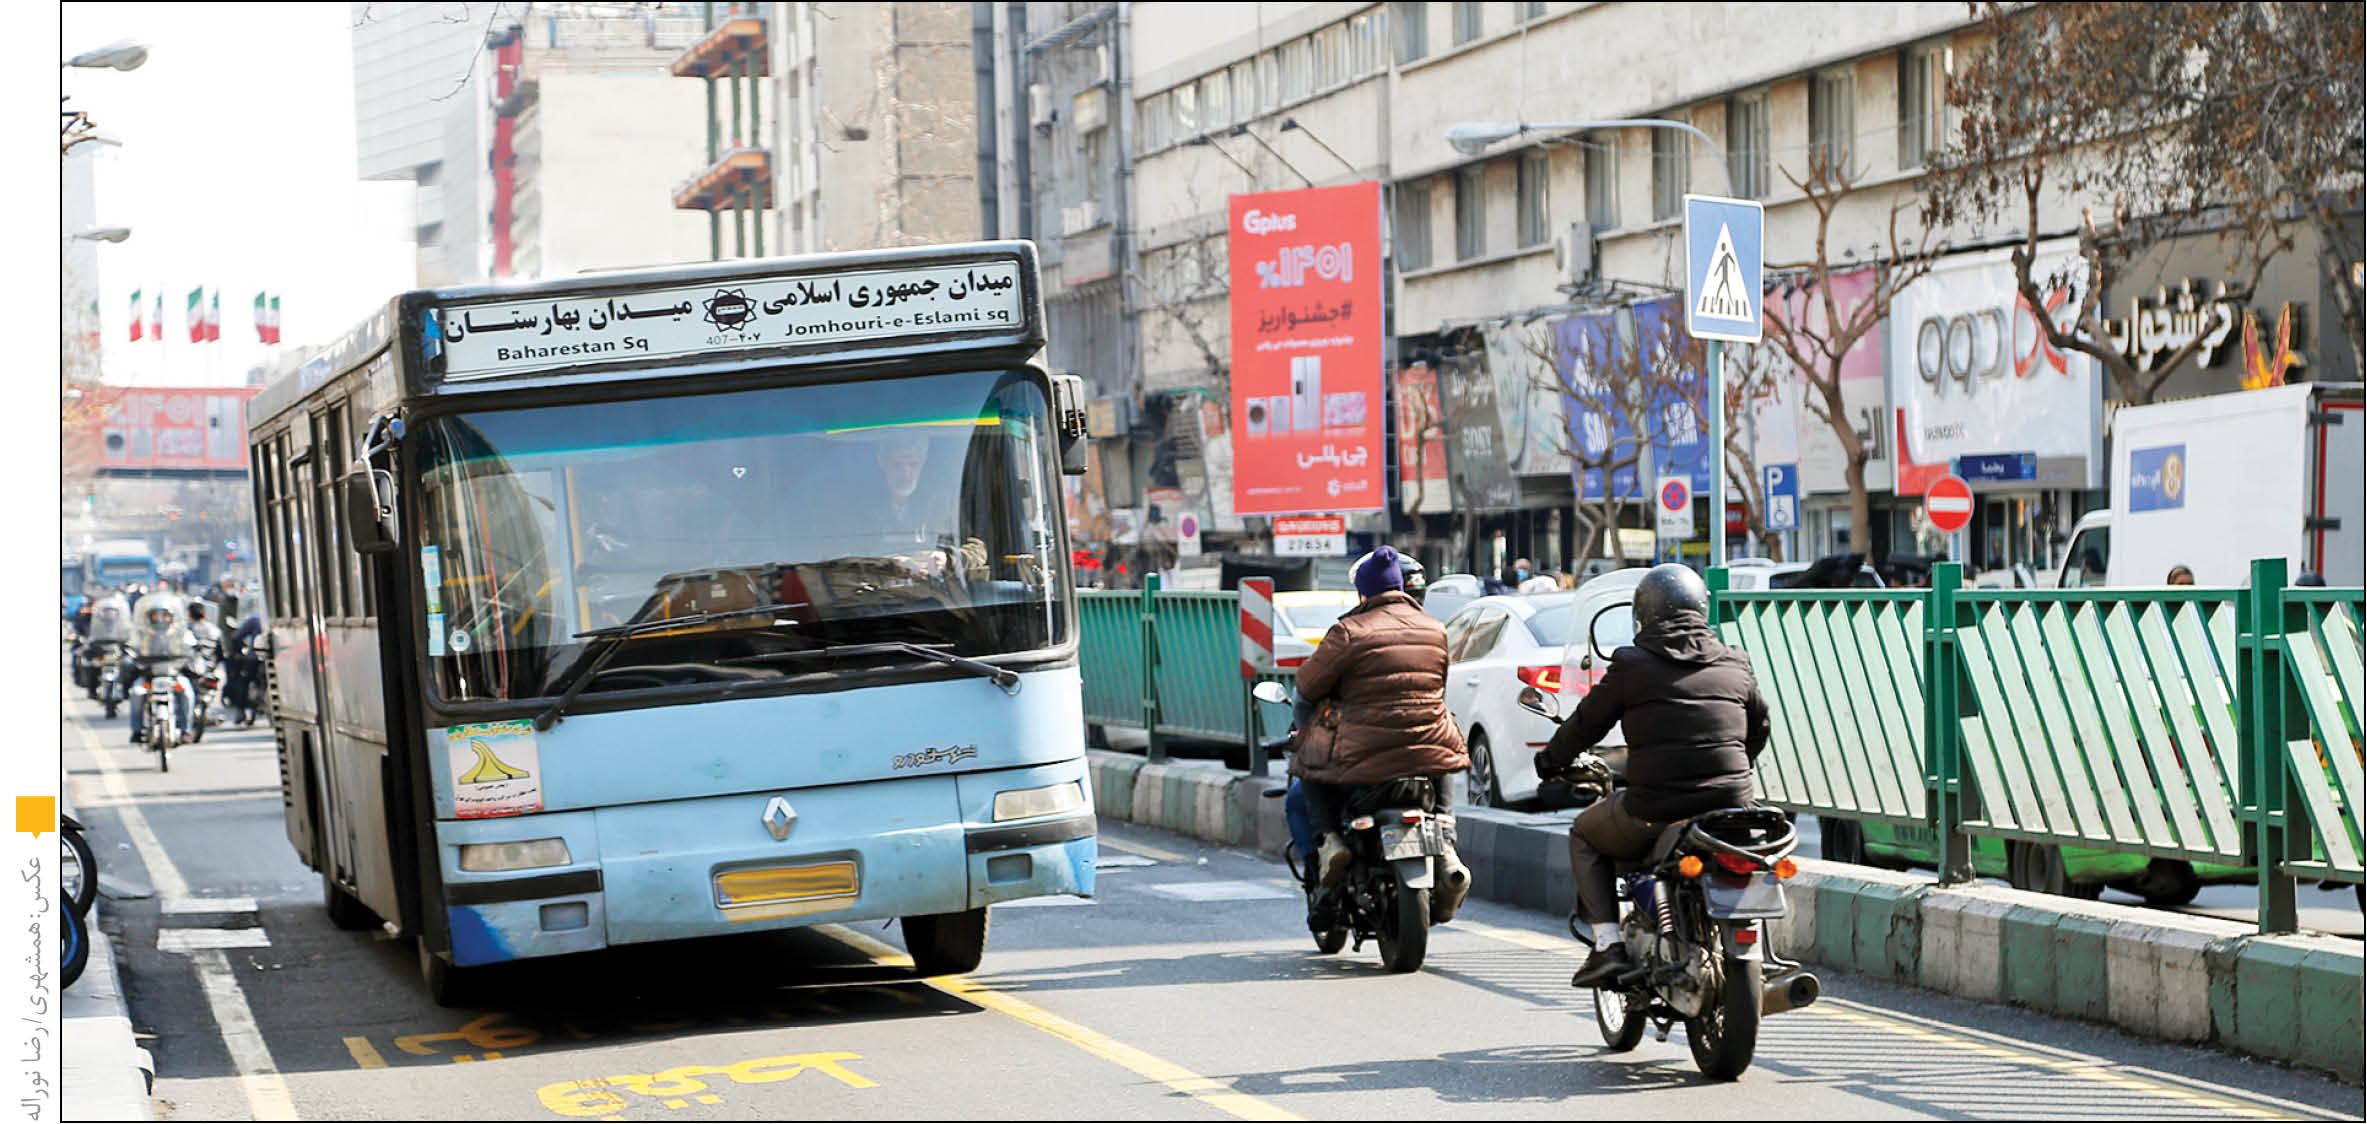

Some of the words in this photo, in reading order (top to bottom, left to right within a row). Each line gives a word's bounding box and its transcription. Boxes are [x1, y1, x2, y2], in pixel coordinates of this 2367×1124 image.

[1243, 209, 1297, 235] Gplus
[762, 278, 841, 316] اسلامی
[848, 279, 940, 308] جمهوری
[948, 269, 1014, 300] میدان
[445, 302, 581, 343] بهارستان
[588, 298, 693, 331] میدان
[785, 308, 981, 338] Jomhouri-e-Eslami
[497, 339, 616, 361] Baharestan
[622, 336, 650, 353] Sq
[1767, 467, 1784, 495] P
